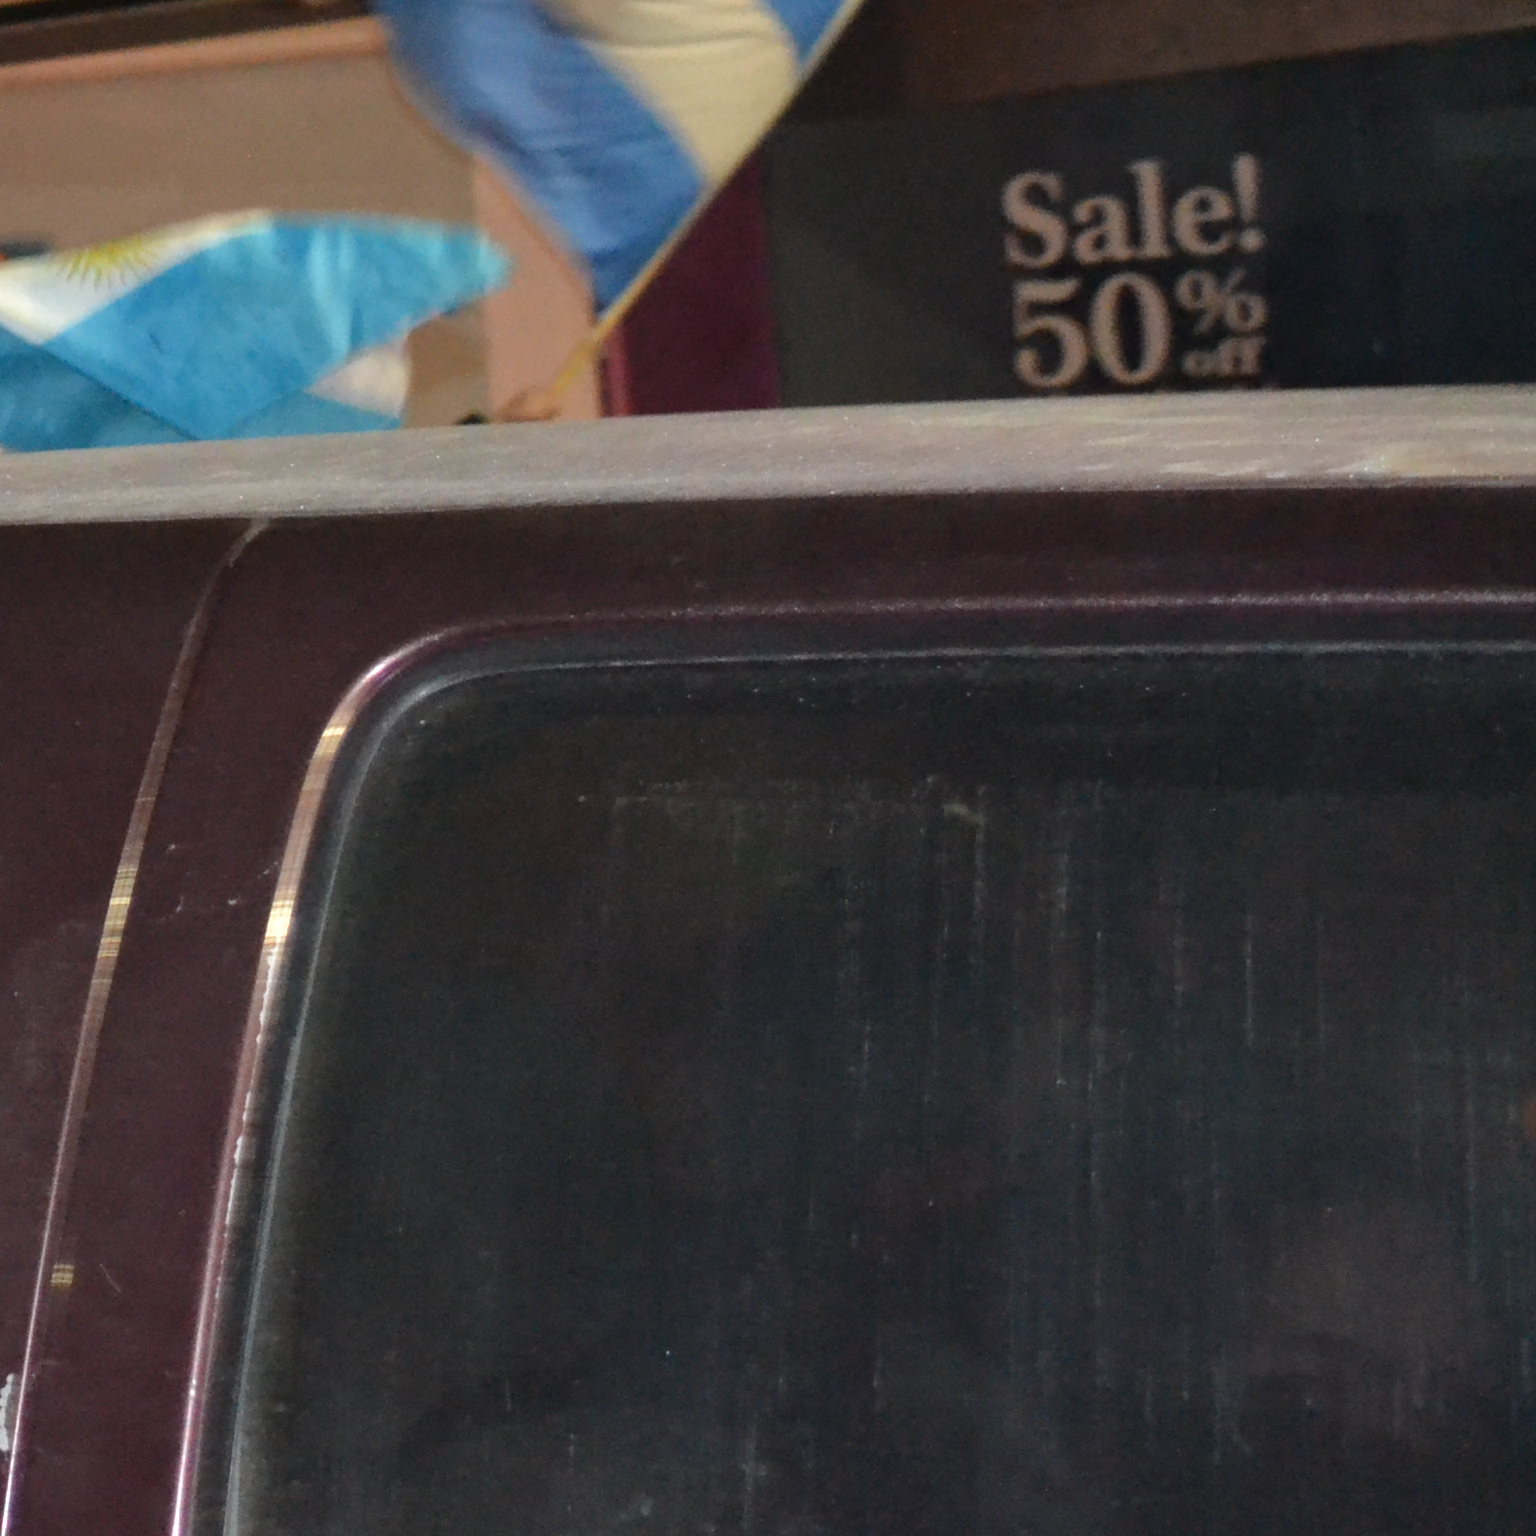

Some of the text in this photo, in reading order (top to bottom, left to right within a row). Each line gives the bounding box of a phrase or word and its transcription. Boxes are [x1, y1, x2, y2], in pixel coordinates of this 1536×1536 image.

[1002, 153, 1266, 265] Sale!
[1012, 270, 1268, 388] 50% off
